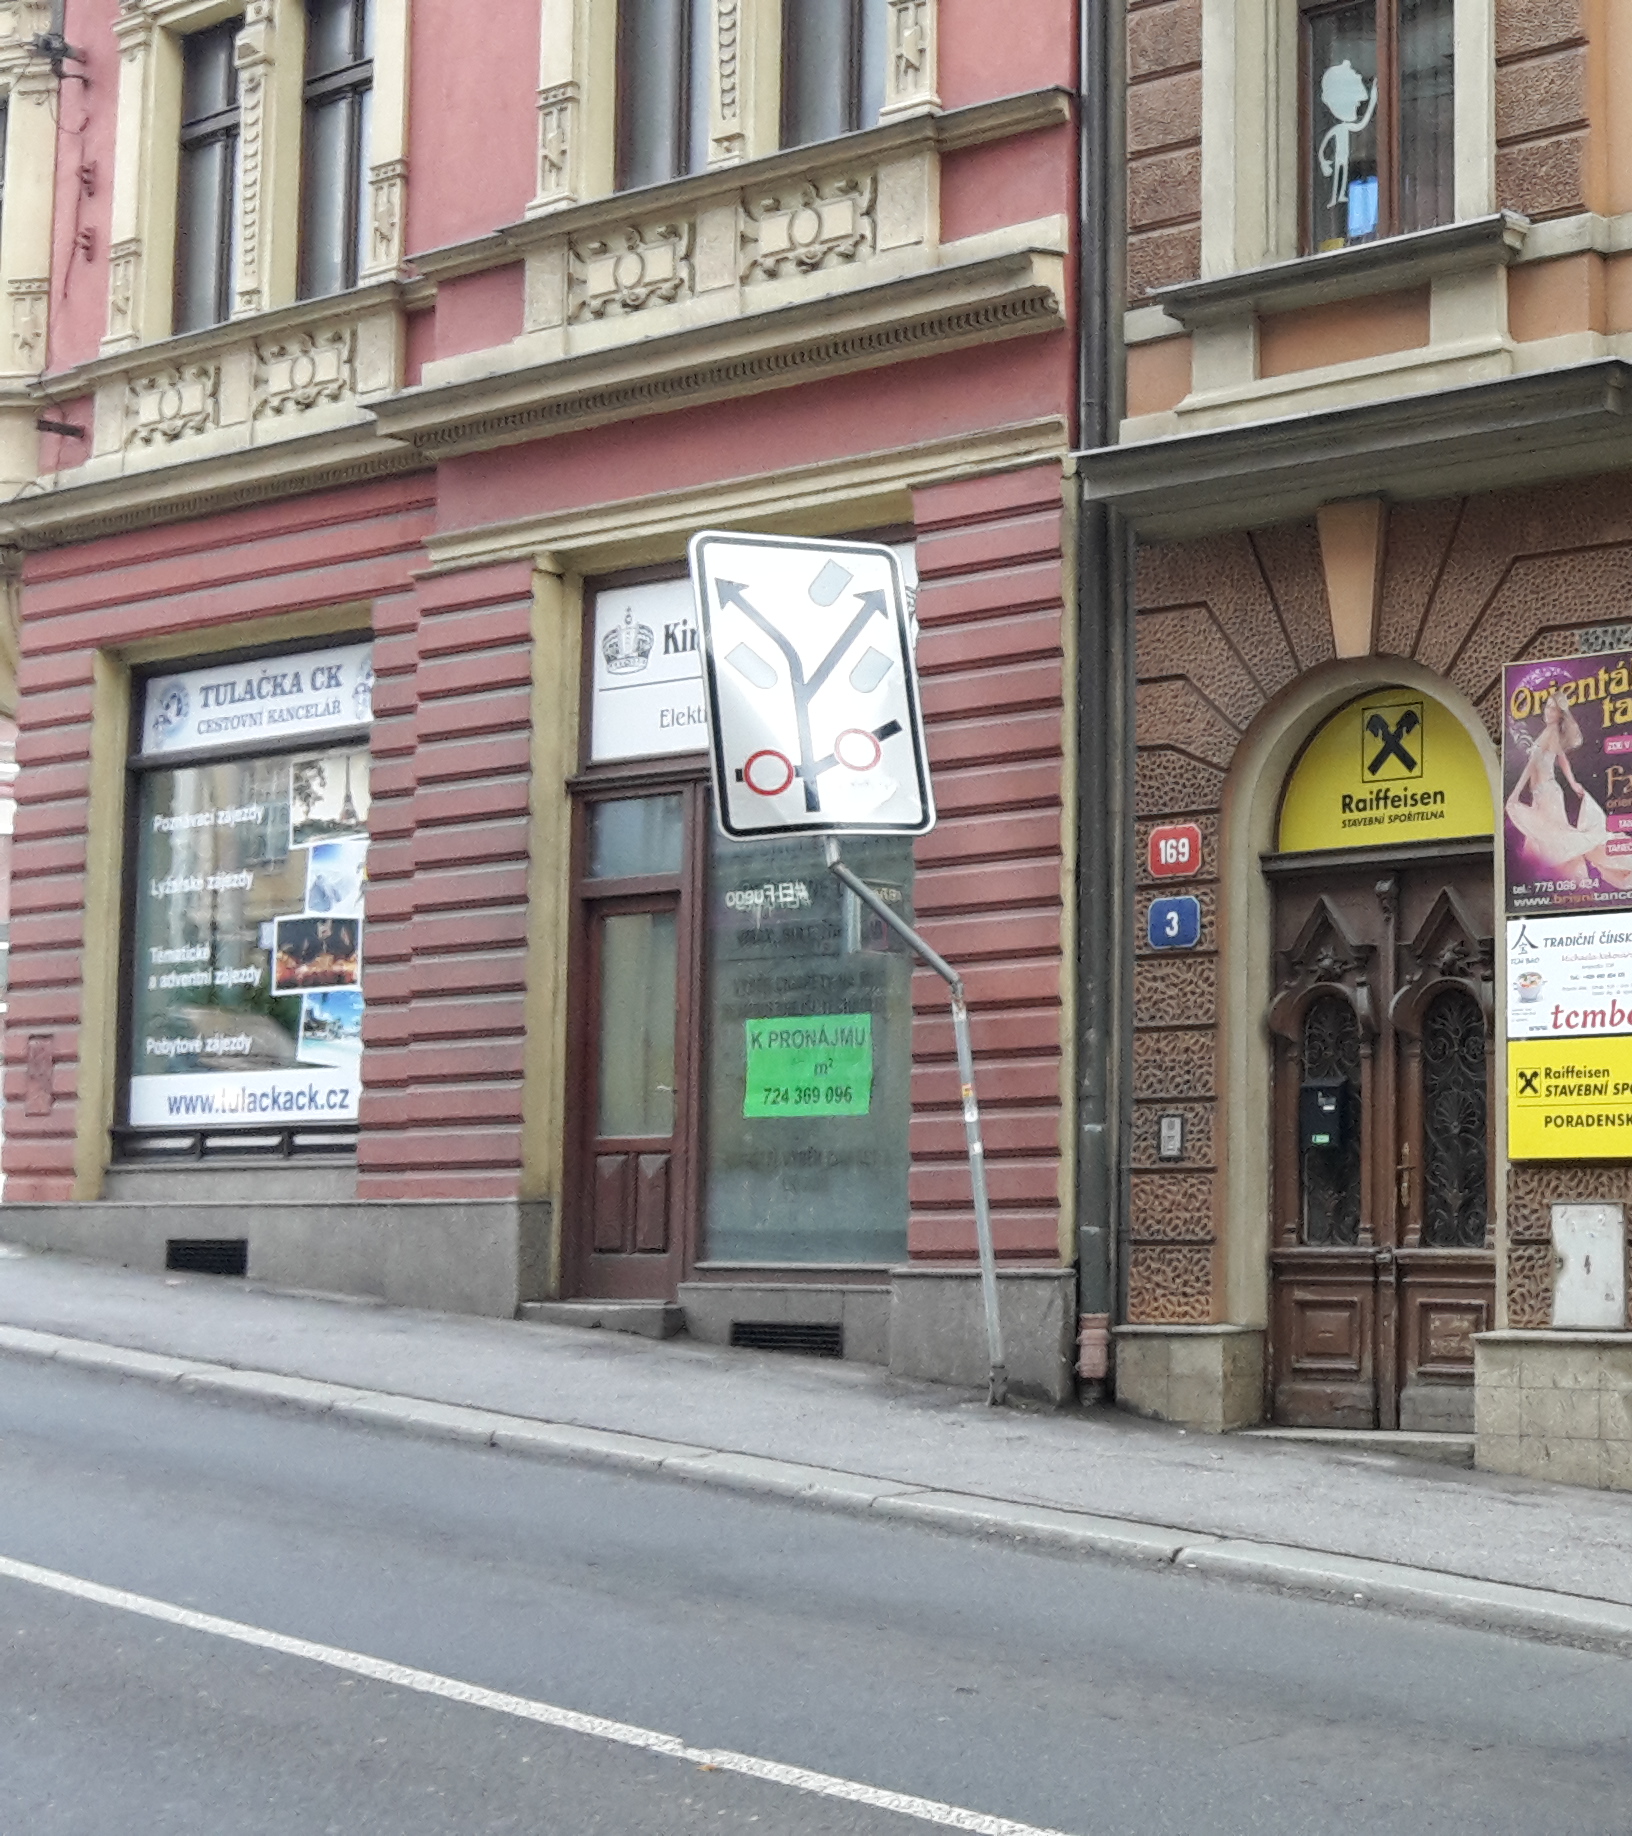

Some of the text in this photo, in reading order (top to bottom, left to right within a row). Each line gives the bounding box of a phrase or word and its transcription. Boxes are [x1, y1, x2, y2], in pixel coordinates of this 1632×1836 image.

[200, 664, 344, 708] TULAČKA CK
[197, 698, 341, 734] CESTOVNÍ KANCELÁŘ
[1341, 786, 1446, 814] Raiffeisen
[1341, 809, 1445, 829] STAVEBNÍ SPOŘITELNA
[1159, 837, 1191, 866] 169
[1166, 911, 1180, 938] 3
[1543, 931, 1595, 948] TRADIČNÍ
[751, 1024, 867, 1050] K PRONÁJMU
[1544, 1065, 1610, 1081] Raiffeisen
[764, 1087, 789, 1106] 724
[825, 1085, 853, 1104] 096
[1544, 1080, 1608, 1098] STAVEBNÍ
